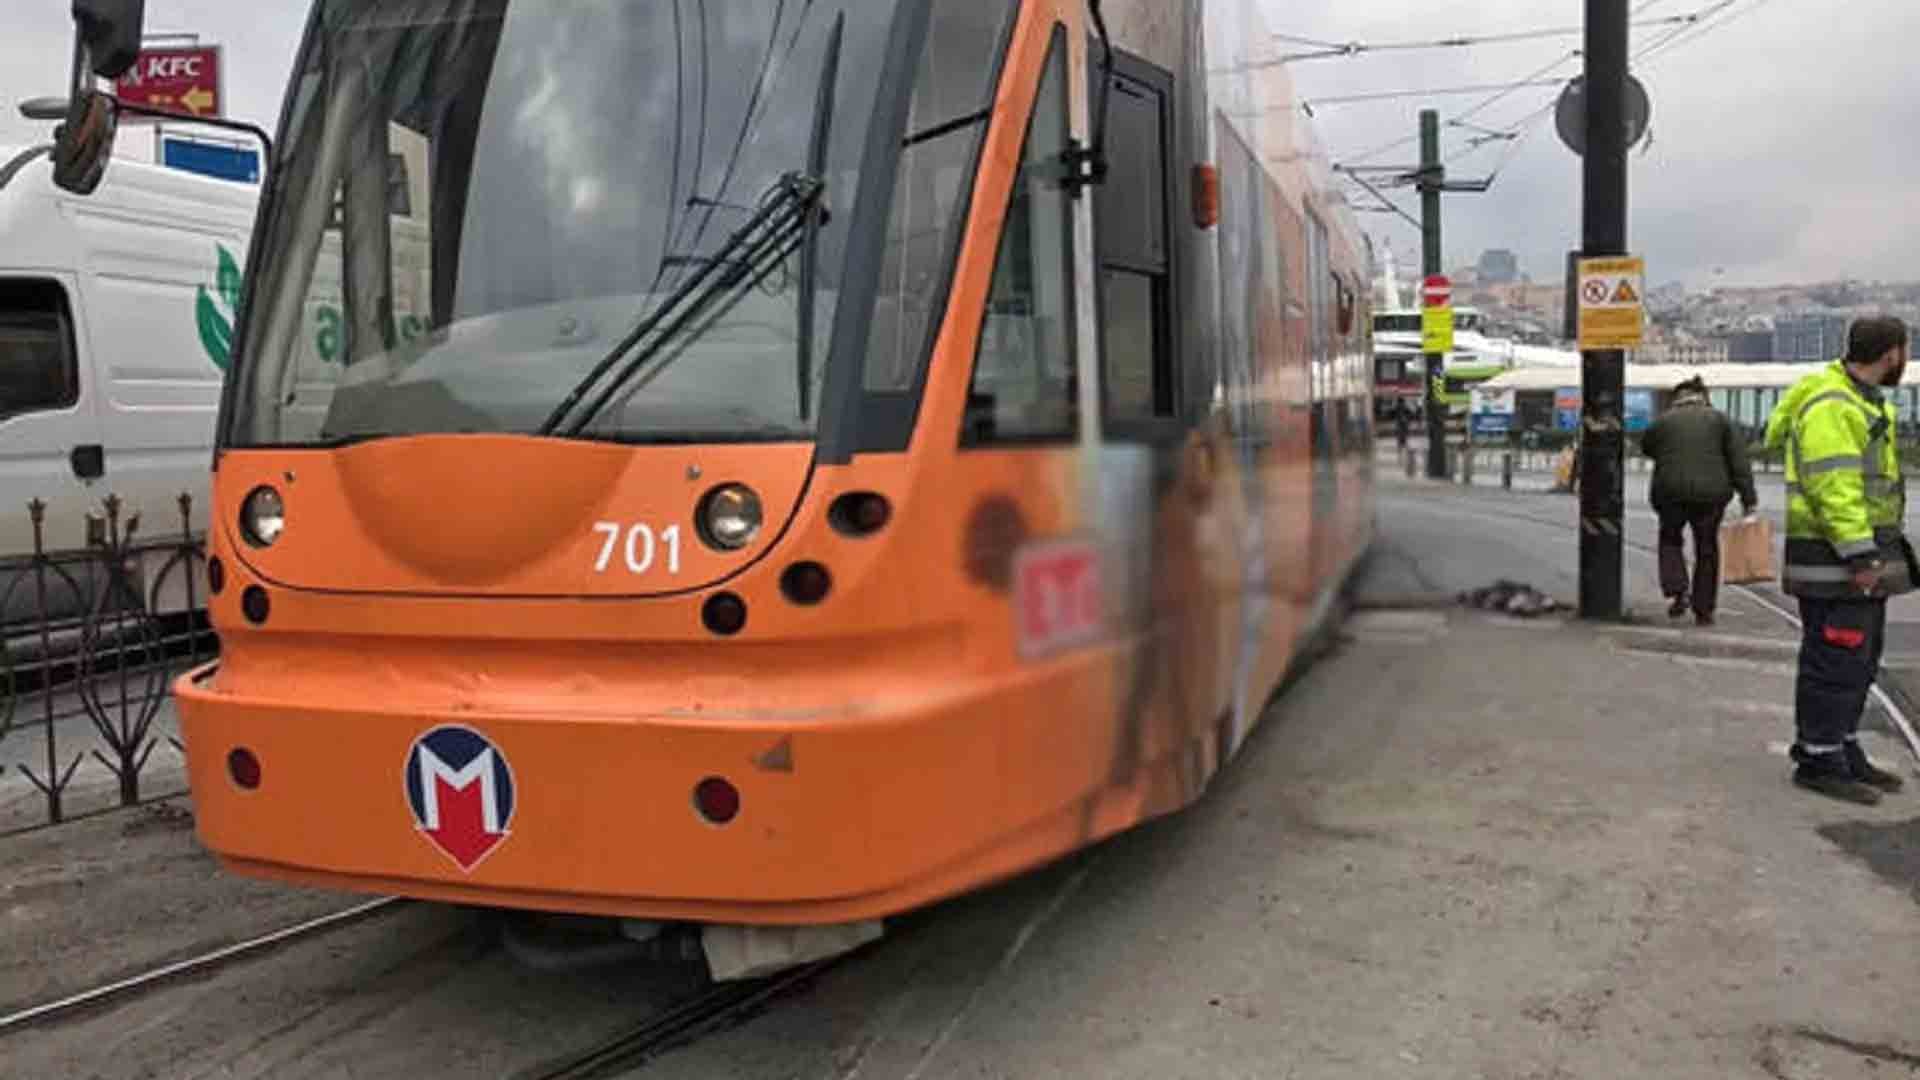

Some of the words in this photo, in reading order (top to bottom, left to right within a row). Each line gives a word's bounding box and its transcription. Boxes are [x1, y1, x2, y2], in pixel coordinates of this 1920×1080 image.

[148, 56, 203, 77] KFC
[593, 520, 681, 574] 701
[418, 743, 499, 834] M
